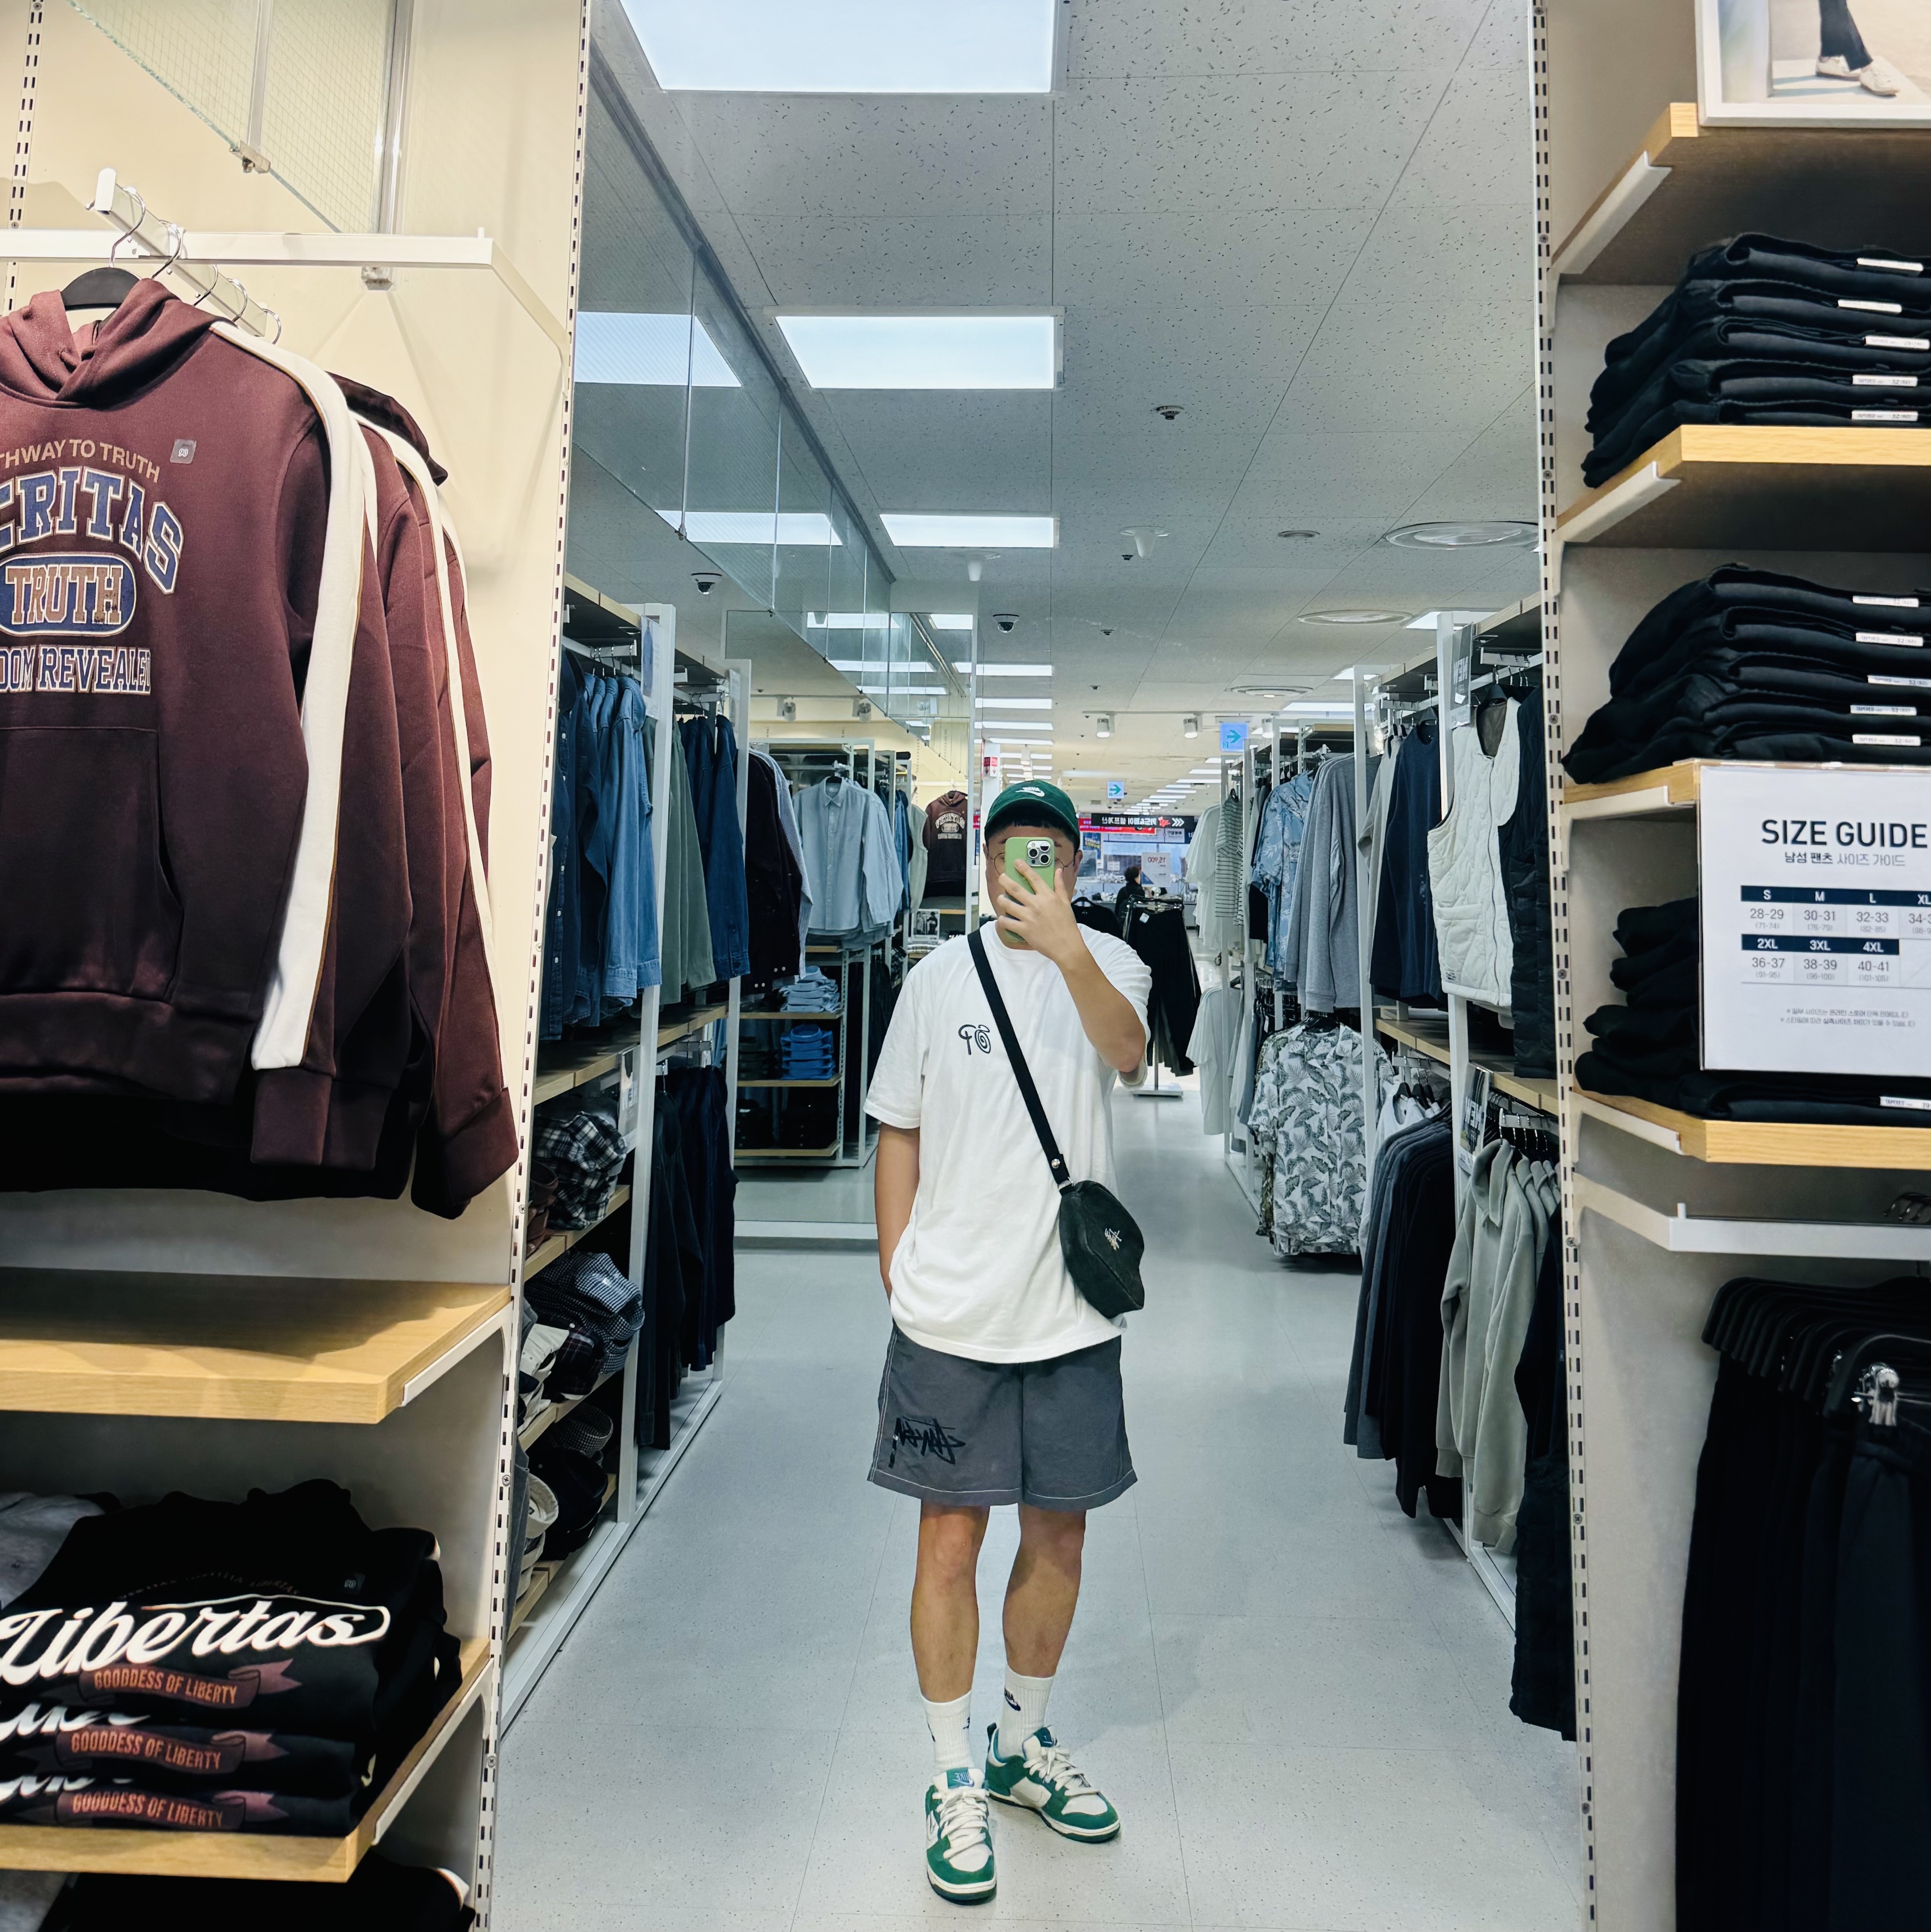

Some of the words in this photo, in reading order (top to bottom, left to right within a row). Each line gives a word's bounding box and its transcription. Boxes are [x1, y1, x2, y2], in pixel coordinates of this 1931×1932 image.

[69, 440, 96, 458] TO
[100, 442, 160, 483] TRUTH
[6, 565, 123, 624] TRUTH
[1761, 819, 1827, 846] SIZE
[1836, 822, 1928, 848] GUIDE
[1785, 852, 1807, 864] 남성
[1811, 852, 1833, 865] 팬츠
[1837, 853, 1870, 866] 사이즈
[1873, 853, 1905, 866] 가이드
[1763, 890, 1771, 900] S
[1815, 891, 1825, 901] M
[1869, 893, 1876, 903] L
[1918, 894, 1931, 905] XL
[1750, 908, 1784, 919] 28-29
[1804, 910, 1835, 921] 30-31
[1857, 912, 1889, 923] 32-33
[1757, 938, 1778, 949] 2XL
[1810, 940, 1831, 951] 3XL
[1863, 941, 1884, 952] 4XL
[1752, 957, 1785, 969] 36-37
[1804, 959, 1837, 970] 38-39
[1858, 961, 1889, 972] 40-41
[0, 1595, 391, 1685] Libertas
[166, 1674, 184, 1693] OF
[186, 1678, 238, 1704] LIBERTY
[145, 1738, 164, 1758] OF
[165, 1744, 221, 1769] LIBERTY
[147, 1797, 166, 1818] OF
[167, 1802, 222, 1827] LIBERTY
